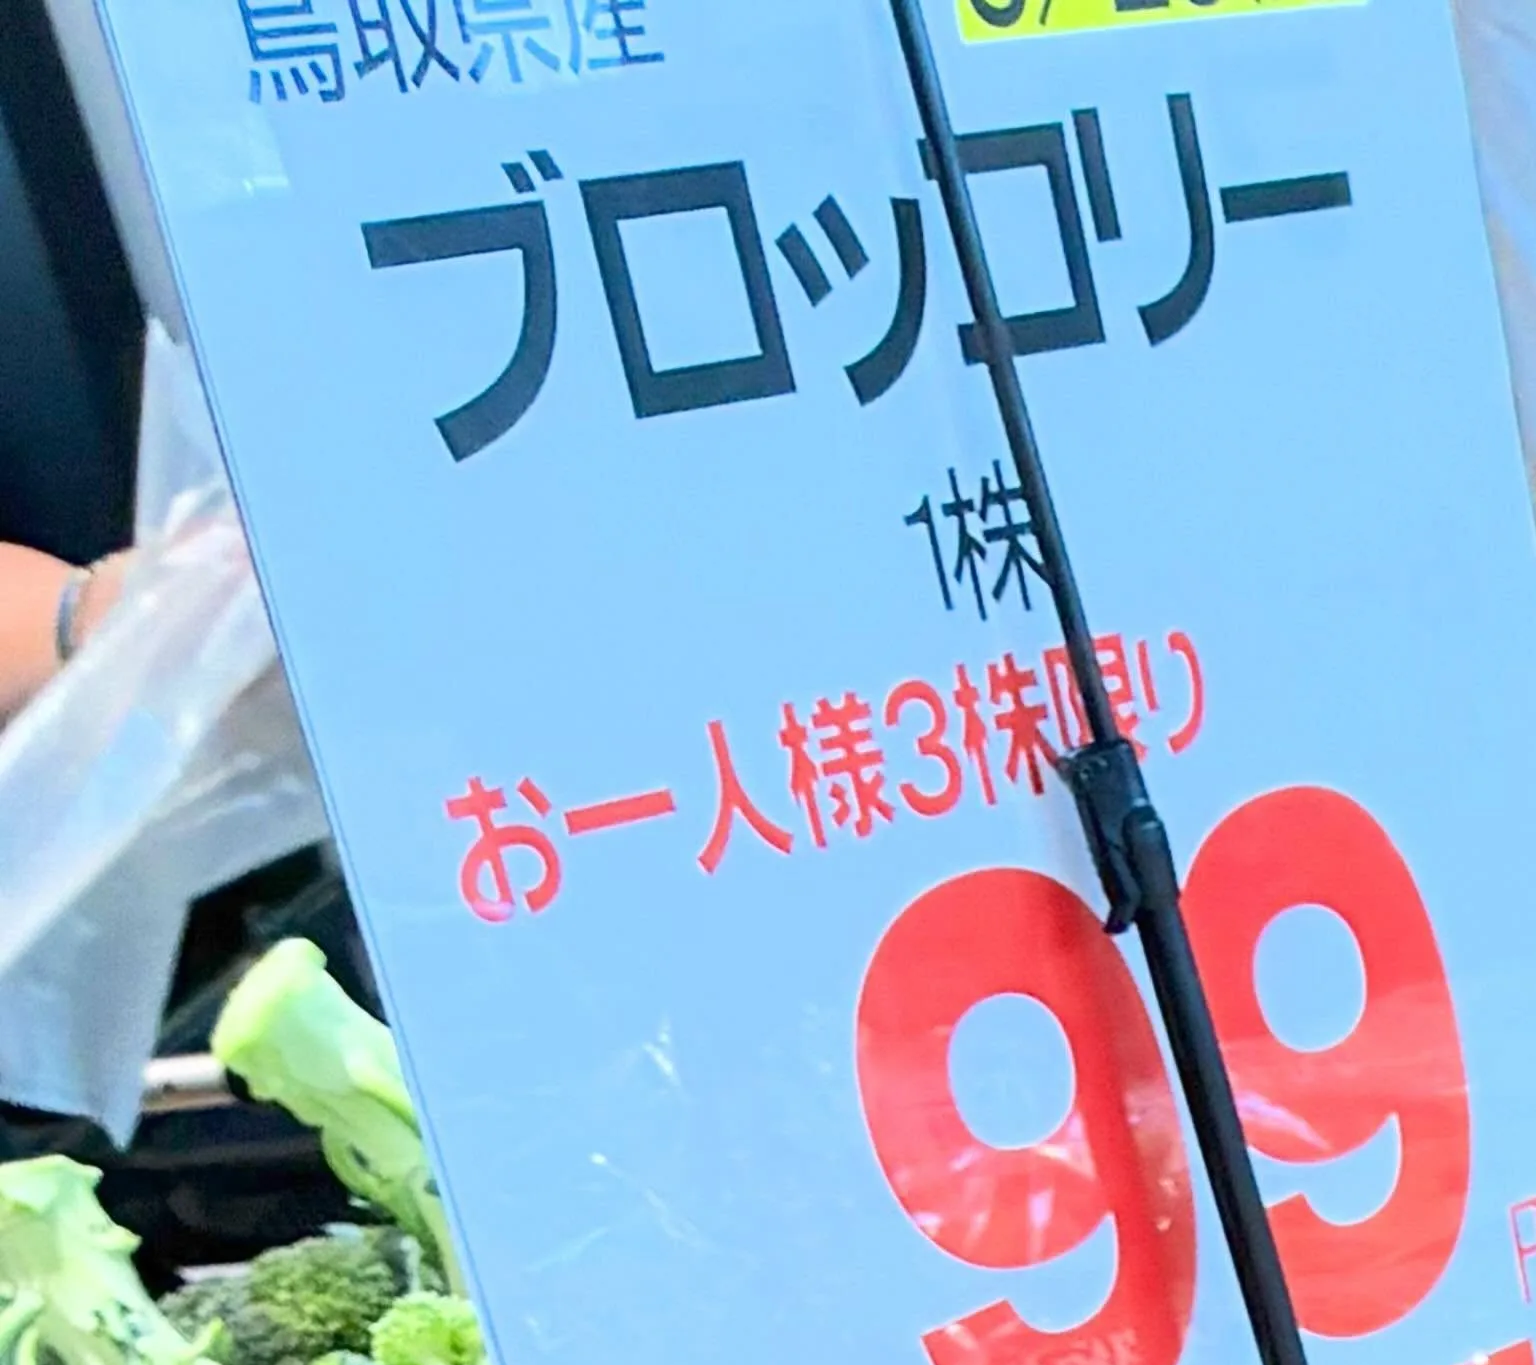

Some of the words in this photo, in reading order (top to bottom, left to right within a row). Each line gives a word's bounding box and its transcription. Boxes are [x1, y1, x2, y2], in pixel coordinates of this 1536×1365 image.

[360, 93, 1351, 463] ブロッコリー
[904, 459, 1054, 621] 1株
[446, 631, 1204, 922] お一人様3株限り
